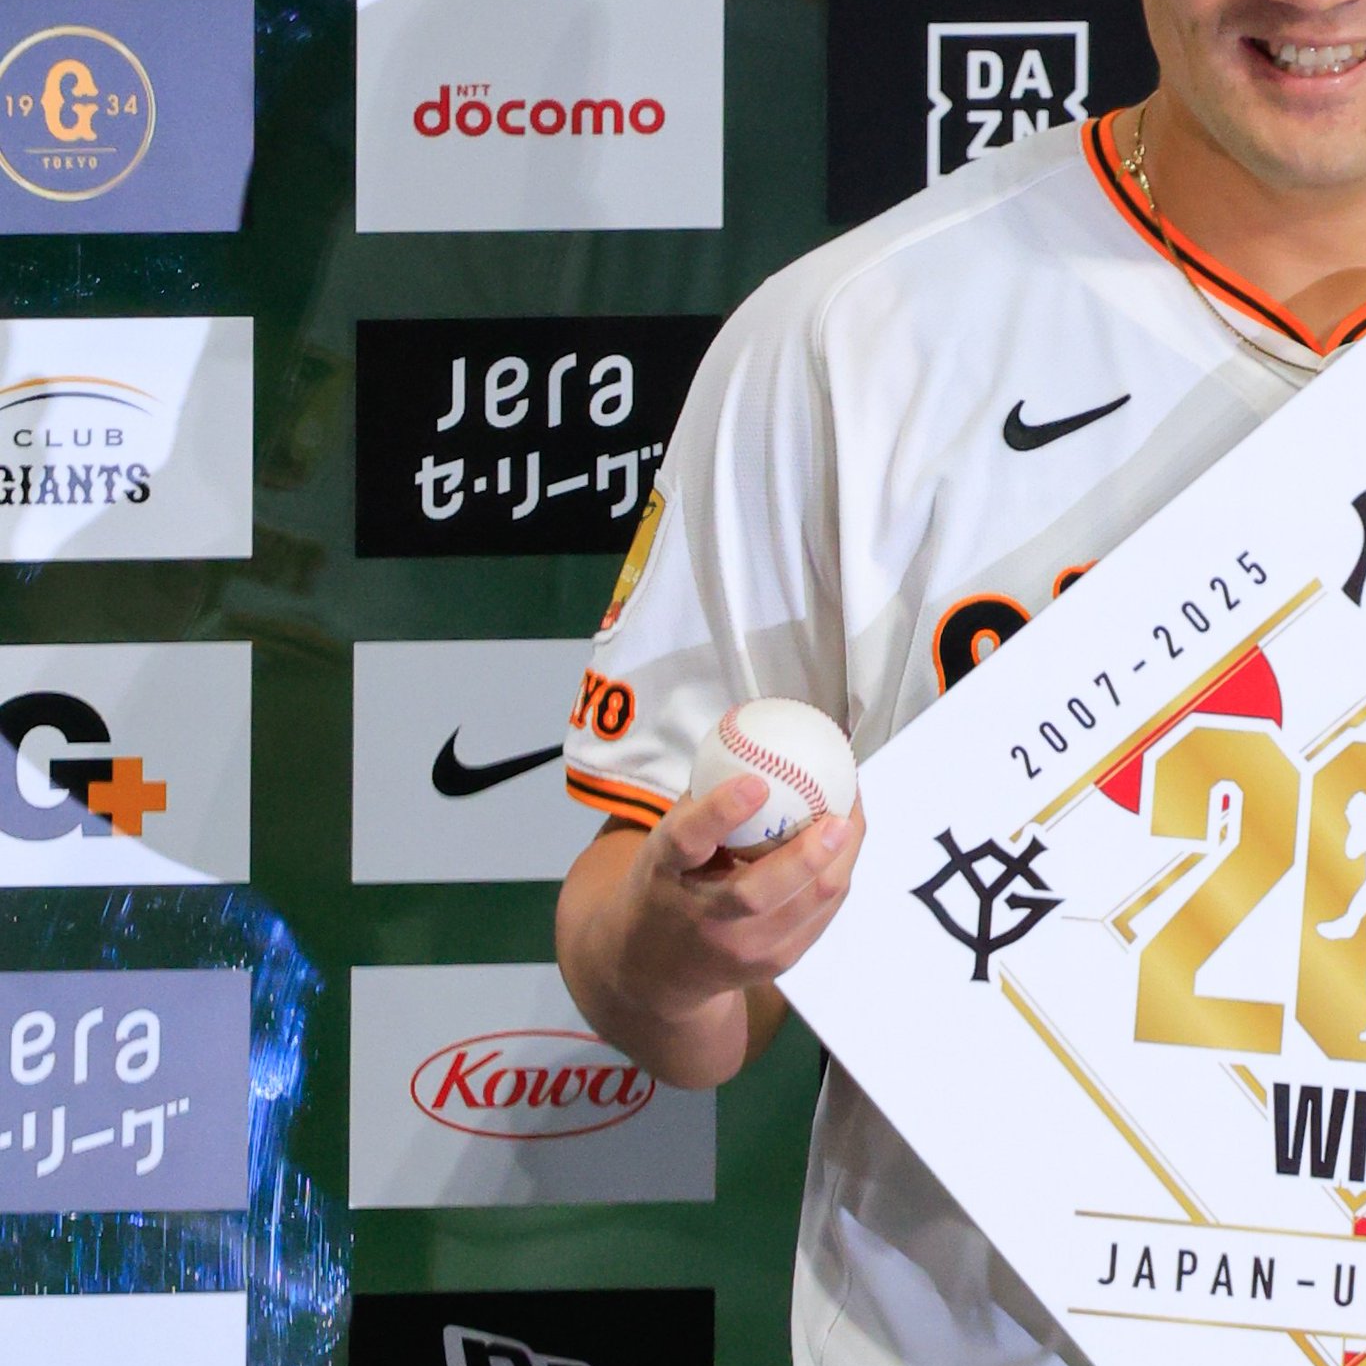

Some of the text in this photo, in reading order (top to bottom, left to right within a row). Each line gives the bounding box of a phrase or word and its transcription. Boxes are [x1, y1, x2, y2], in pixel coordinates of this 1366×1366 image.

[6, 59, 137, 141] 19 G 34
[457, 84, 490, 97] NTT
[967, 50, 1053, 100] DA
[414, 85, 665, 137] docomo
[42, 156, 97, 169] TOKYO
[12, 429, 122, 450] CLUB
[1010, 551, 1269, 780] 2007-2025
[10, 1006, 161, 1086] era
[431, 1051, 647, 1110] Kowa
[0, 1098, 190, 1175] ・リーグ
